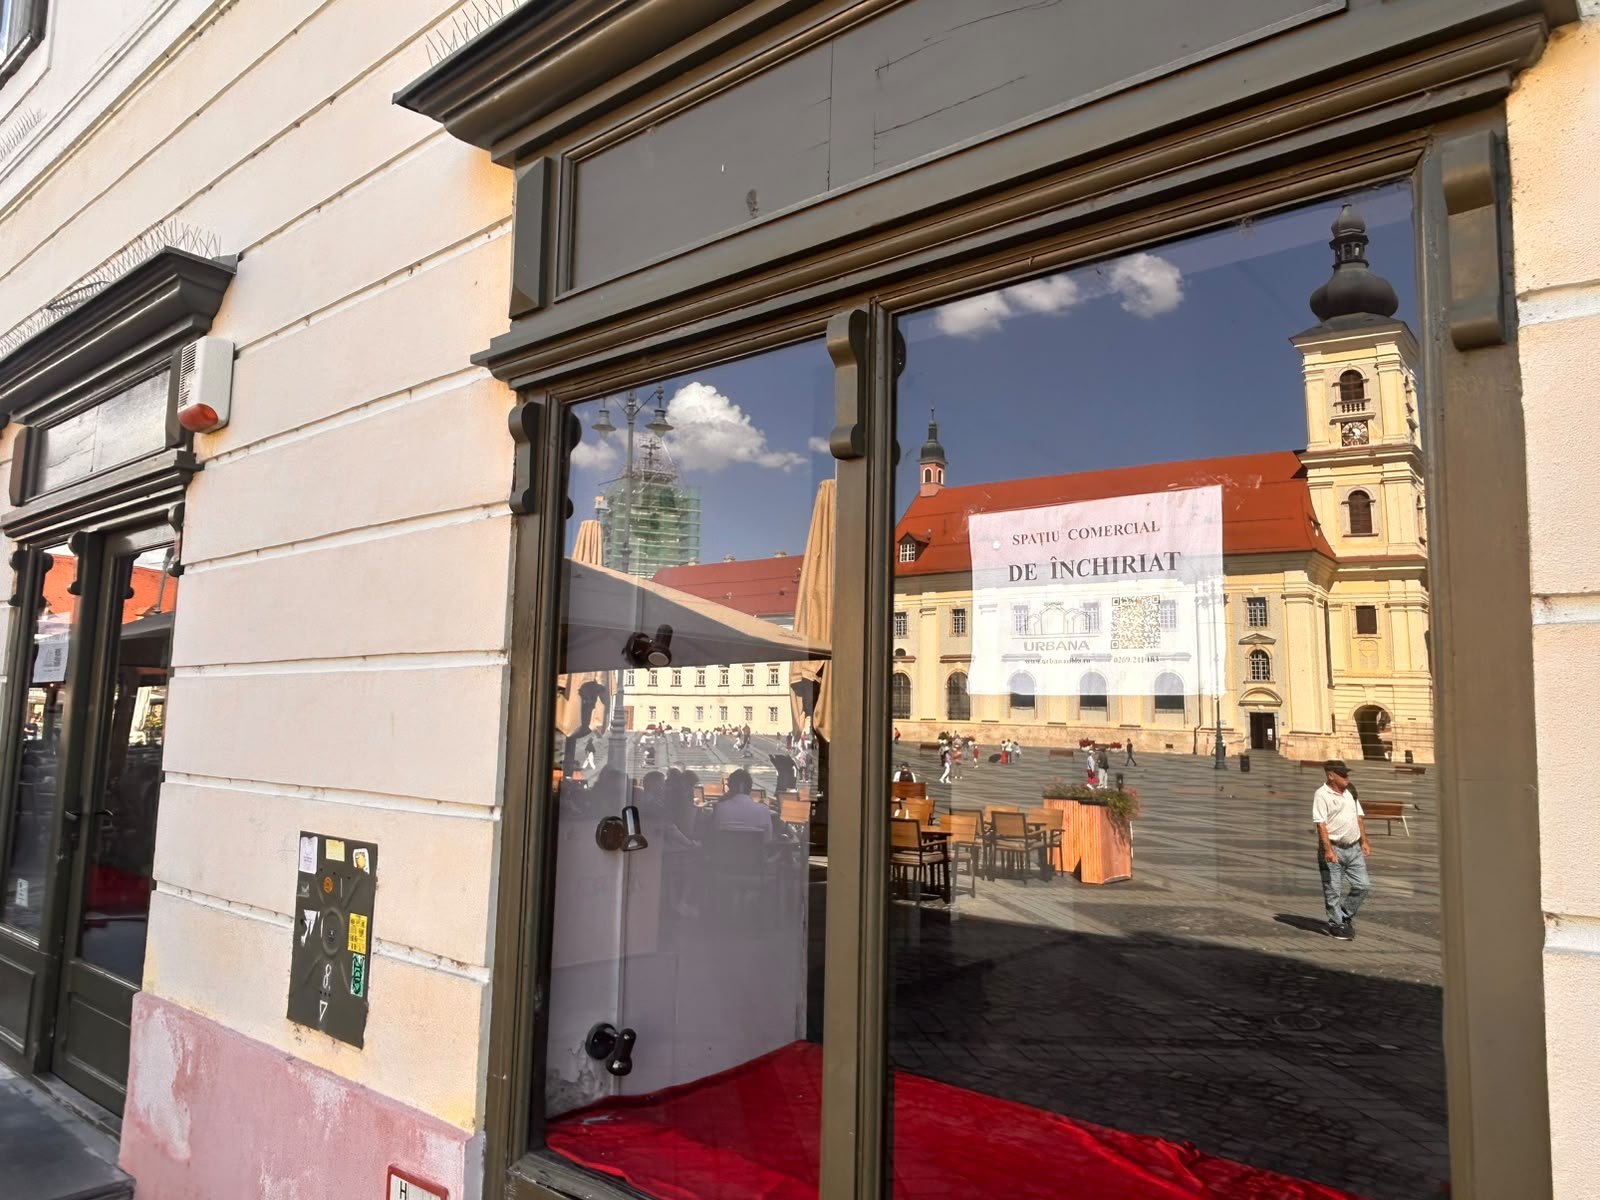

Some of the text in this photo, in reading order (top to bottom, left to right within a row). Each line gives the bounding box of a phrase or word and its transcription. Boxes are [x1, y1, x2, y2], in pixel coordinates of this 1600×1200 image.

[1068, 520, 1161, 541] COMERCIAL
[1008, 551, 1182, 582] DE ÎNCHIRIAT
[1023, 640, 1090, 652] URBANA
[399, 1180, 408, 1200] H
